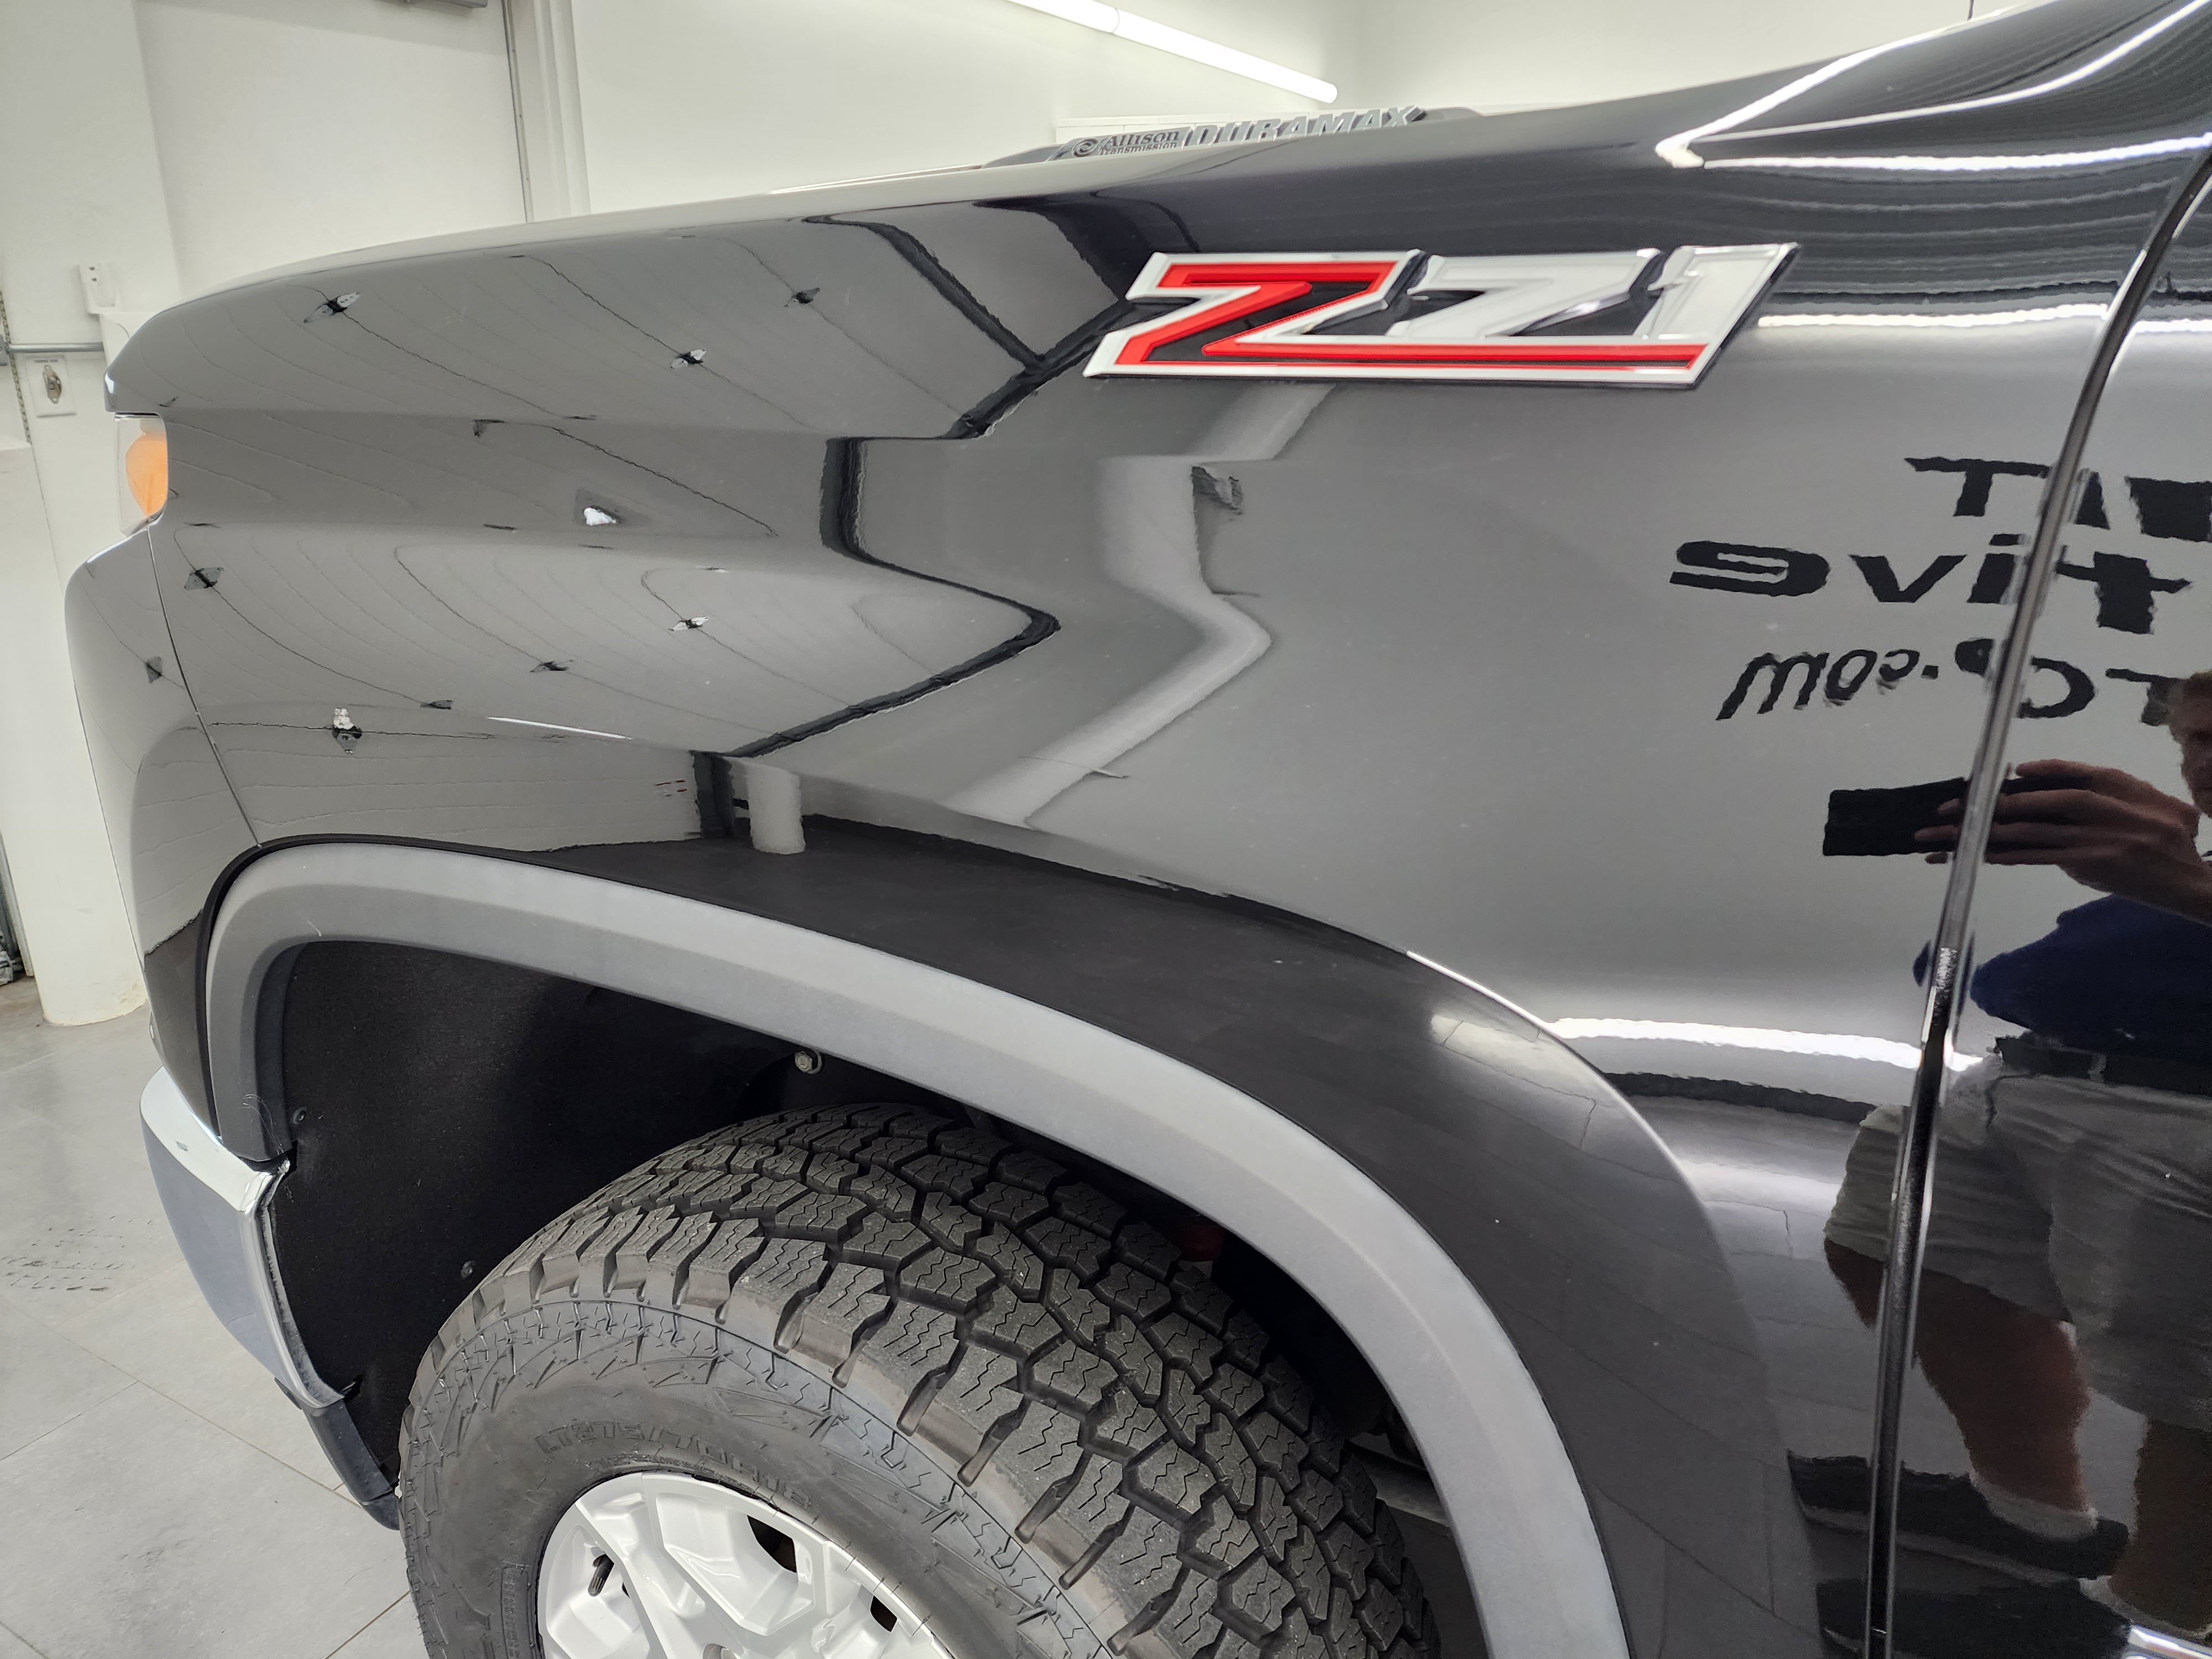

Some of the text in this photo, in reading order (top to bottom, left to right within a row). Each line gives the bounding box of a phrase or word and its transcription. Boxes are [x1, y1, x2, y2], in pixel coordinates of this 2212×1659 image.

[1188, 105, 1426, 147] DURAMAX
[1102, 131, 1180, 148] Allison
[1098, 142, 1177, 156] Transmission
